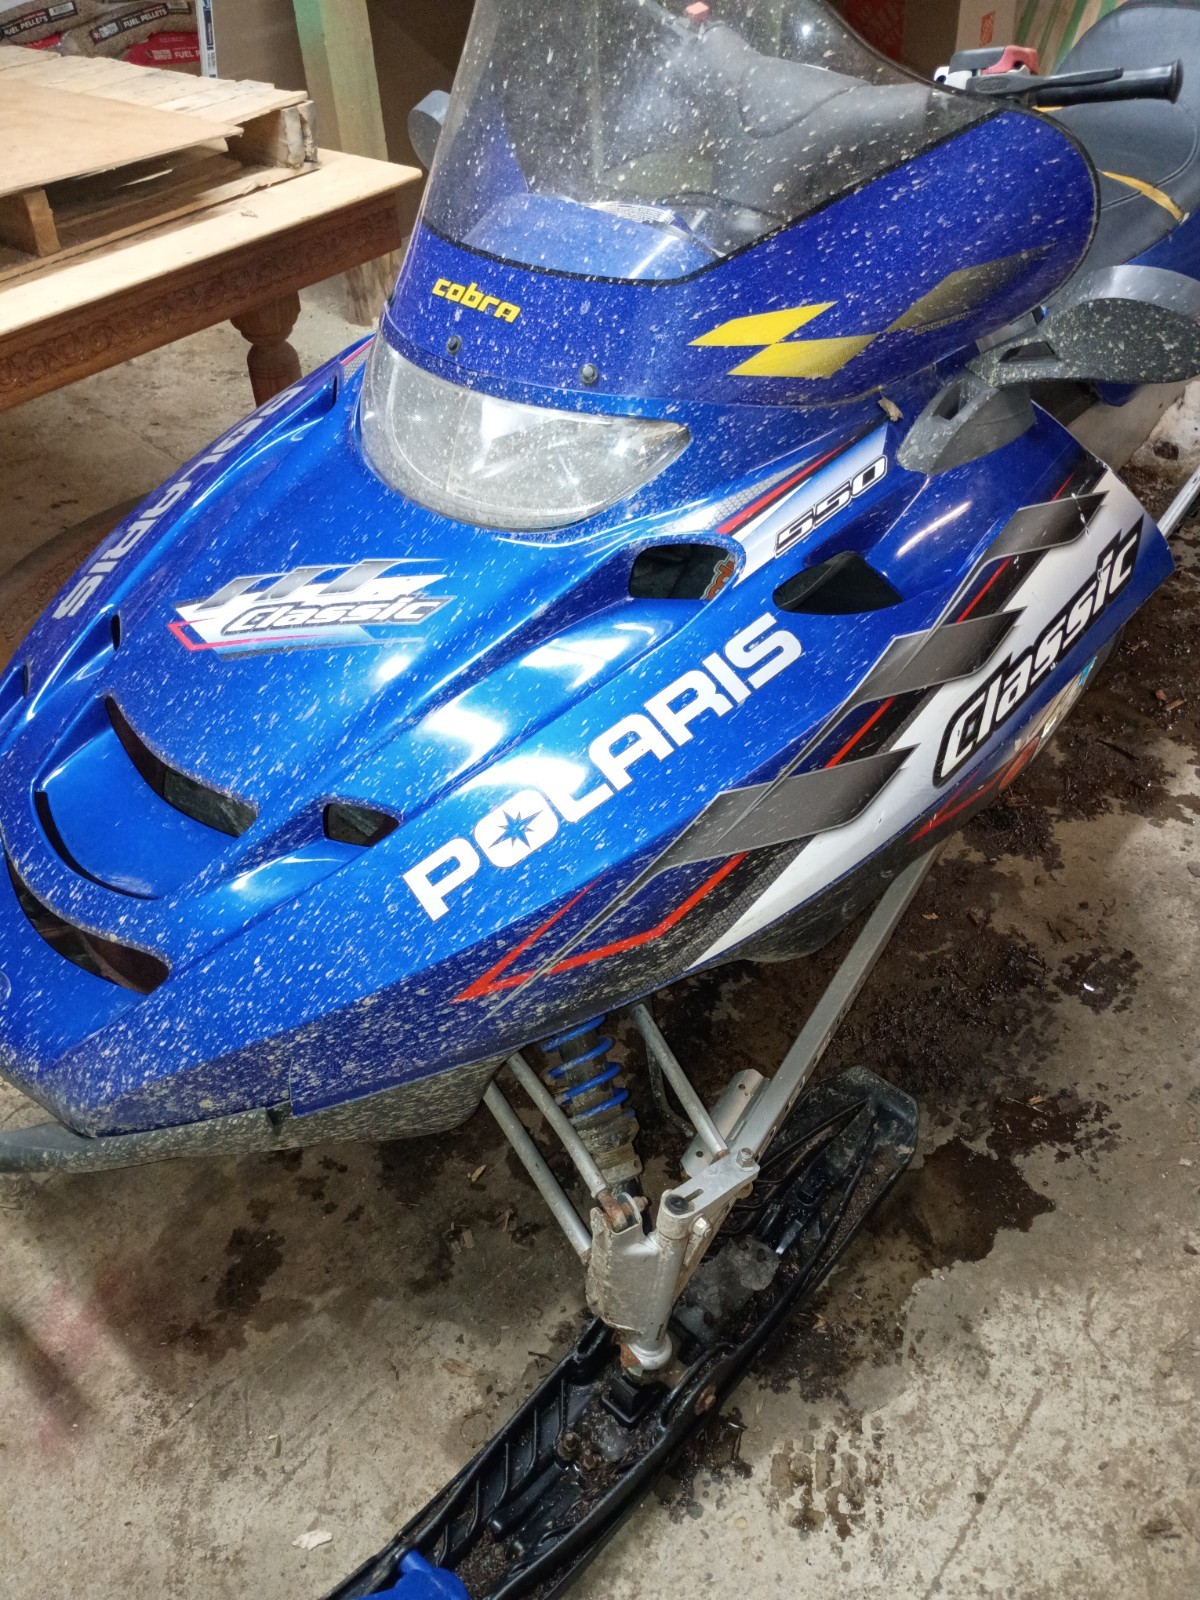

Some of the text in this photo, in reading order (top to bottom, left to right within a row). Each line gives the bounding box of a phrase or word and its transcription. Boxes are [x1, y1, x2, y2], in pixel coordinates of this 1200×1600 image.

[20, 15, 49, 30] PELLETS
[123, 18, 141, 28] FUEL
[140, 8, 168, 22] PELLETS
[174, 51, 194, 59] FUEL
[432, 278, 521, 323] cobra
[52, 386, 306, 619] POLARIS
[774, 455, 887, 558] 550
[222, 595, 452, 636] Classic
[937, 524, 1140, 782] Classic
[402, 612, 802, 922] POLARIS
